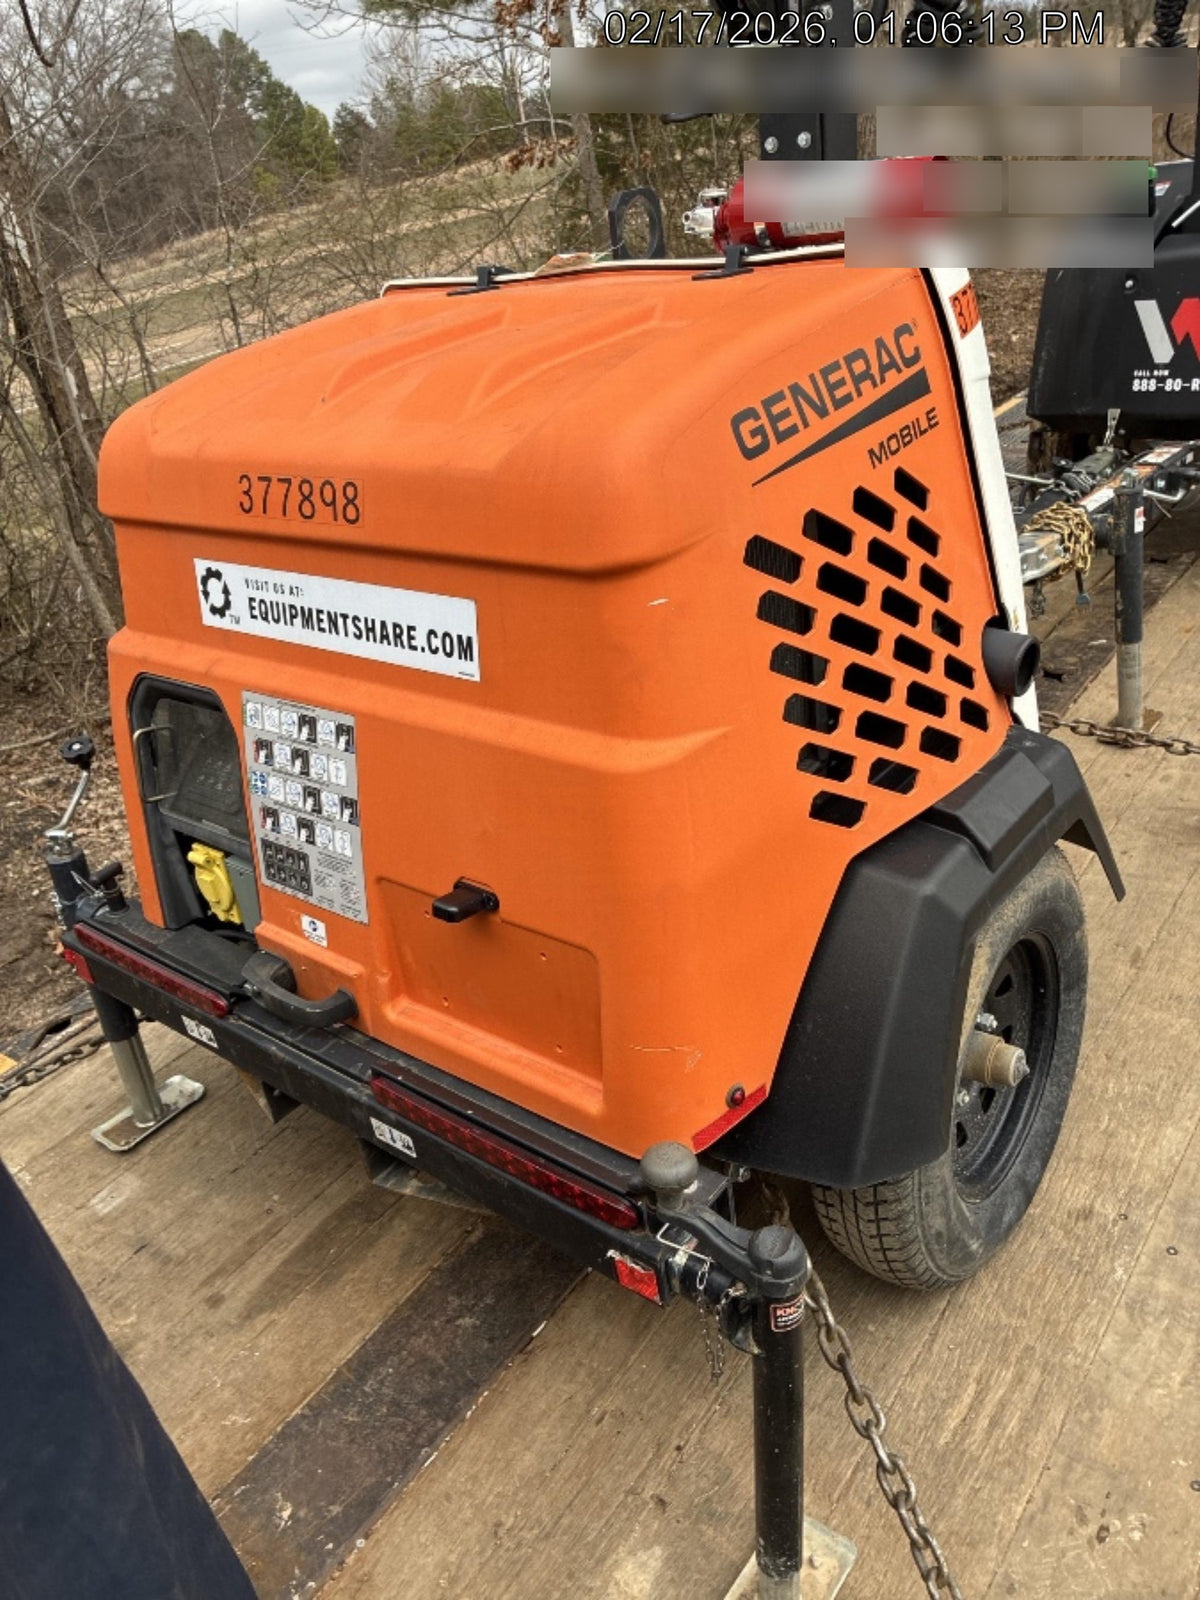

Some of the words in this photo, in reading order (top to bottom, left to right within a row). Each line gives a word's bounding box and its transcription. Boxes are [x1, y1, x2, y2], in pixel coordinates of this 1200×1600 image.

[730, 322, 922, 461] GENERAC
[867, 406, 940, 469] MOBILE
[238, 474, 360, 525] 377898
[244, 578, 269, 593] VISIT
[273, 582, 286, 594] US
[289, 584, 304, 598] AT:
[247, 596, 475, 663] EQUIPMENTSHARE.COM
